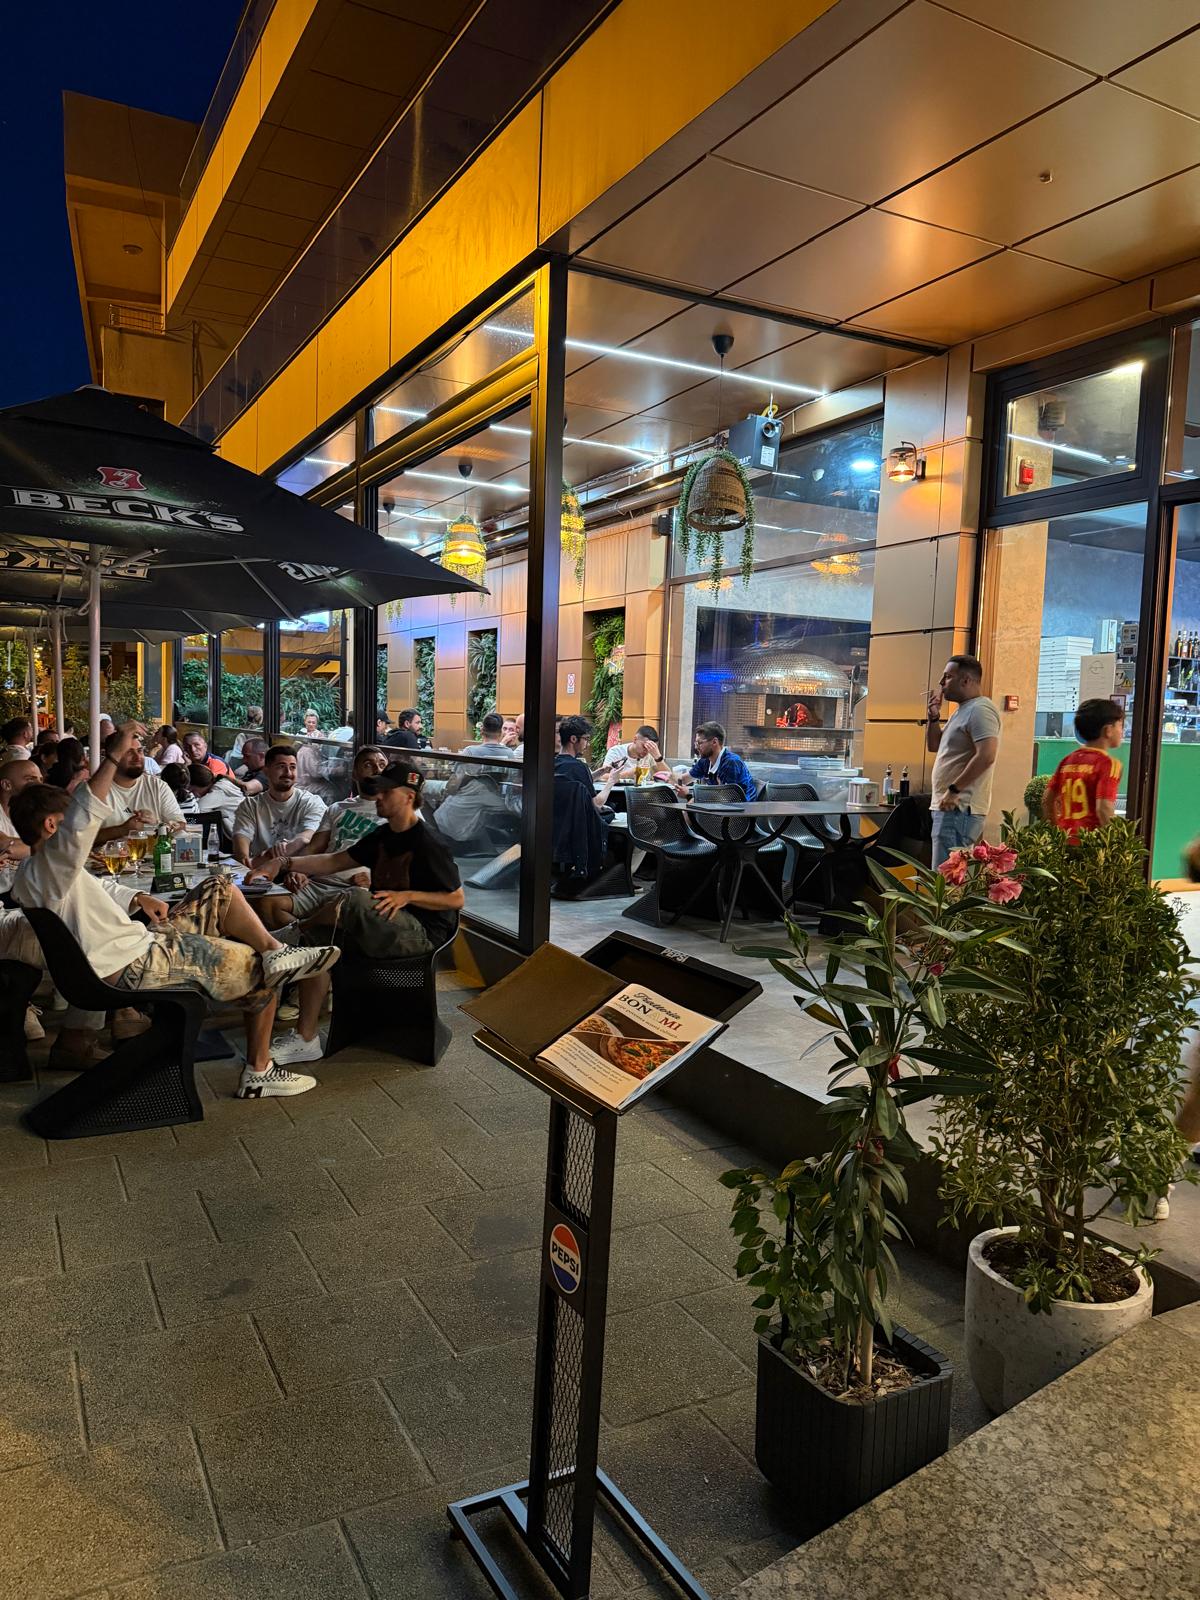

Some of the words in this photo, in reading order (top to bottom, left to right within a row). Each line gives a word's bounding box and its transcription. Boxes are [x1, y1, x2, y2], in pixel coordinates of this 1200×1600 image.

[12, 488, 245, 532] BECK'S
[1061, 778, 1089, 820] 19
[660, 948, 689, 963] PEPSI
[633, 992, 681, 1020] Trattoria
[552, 1241, 579, 1276] PEPSI
